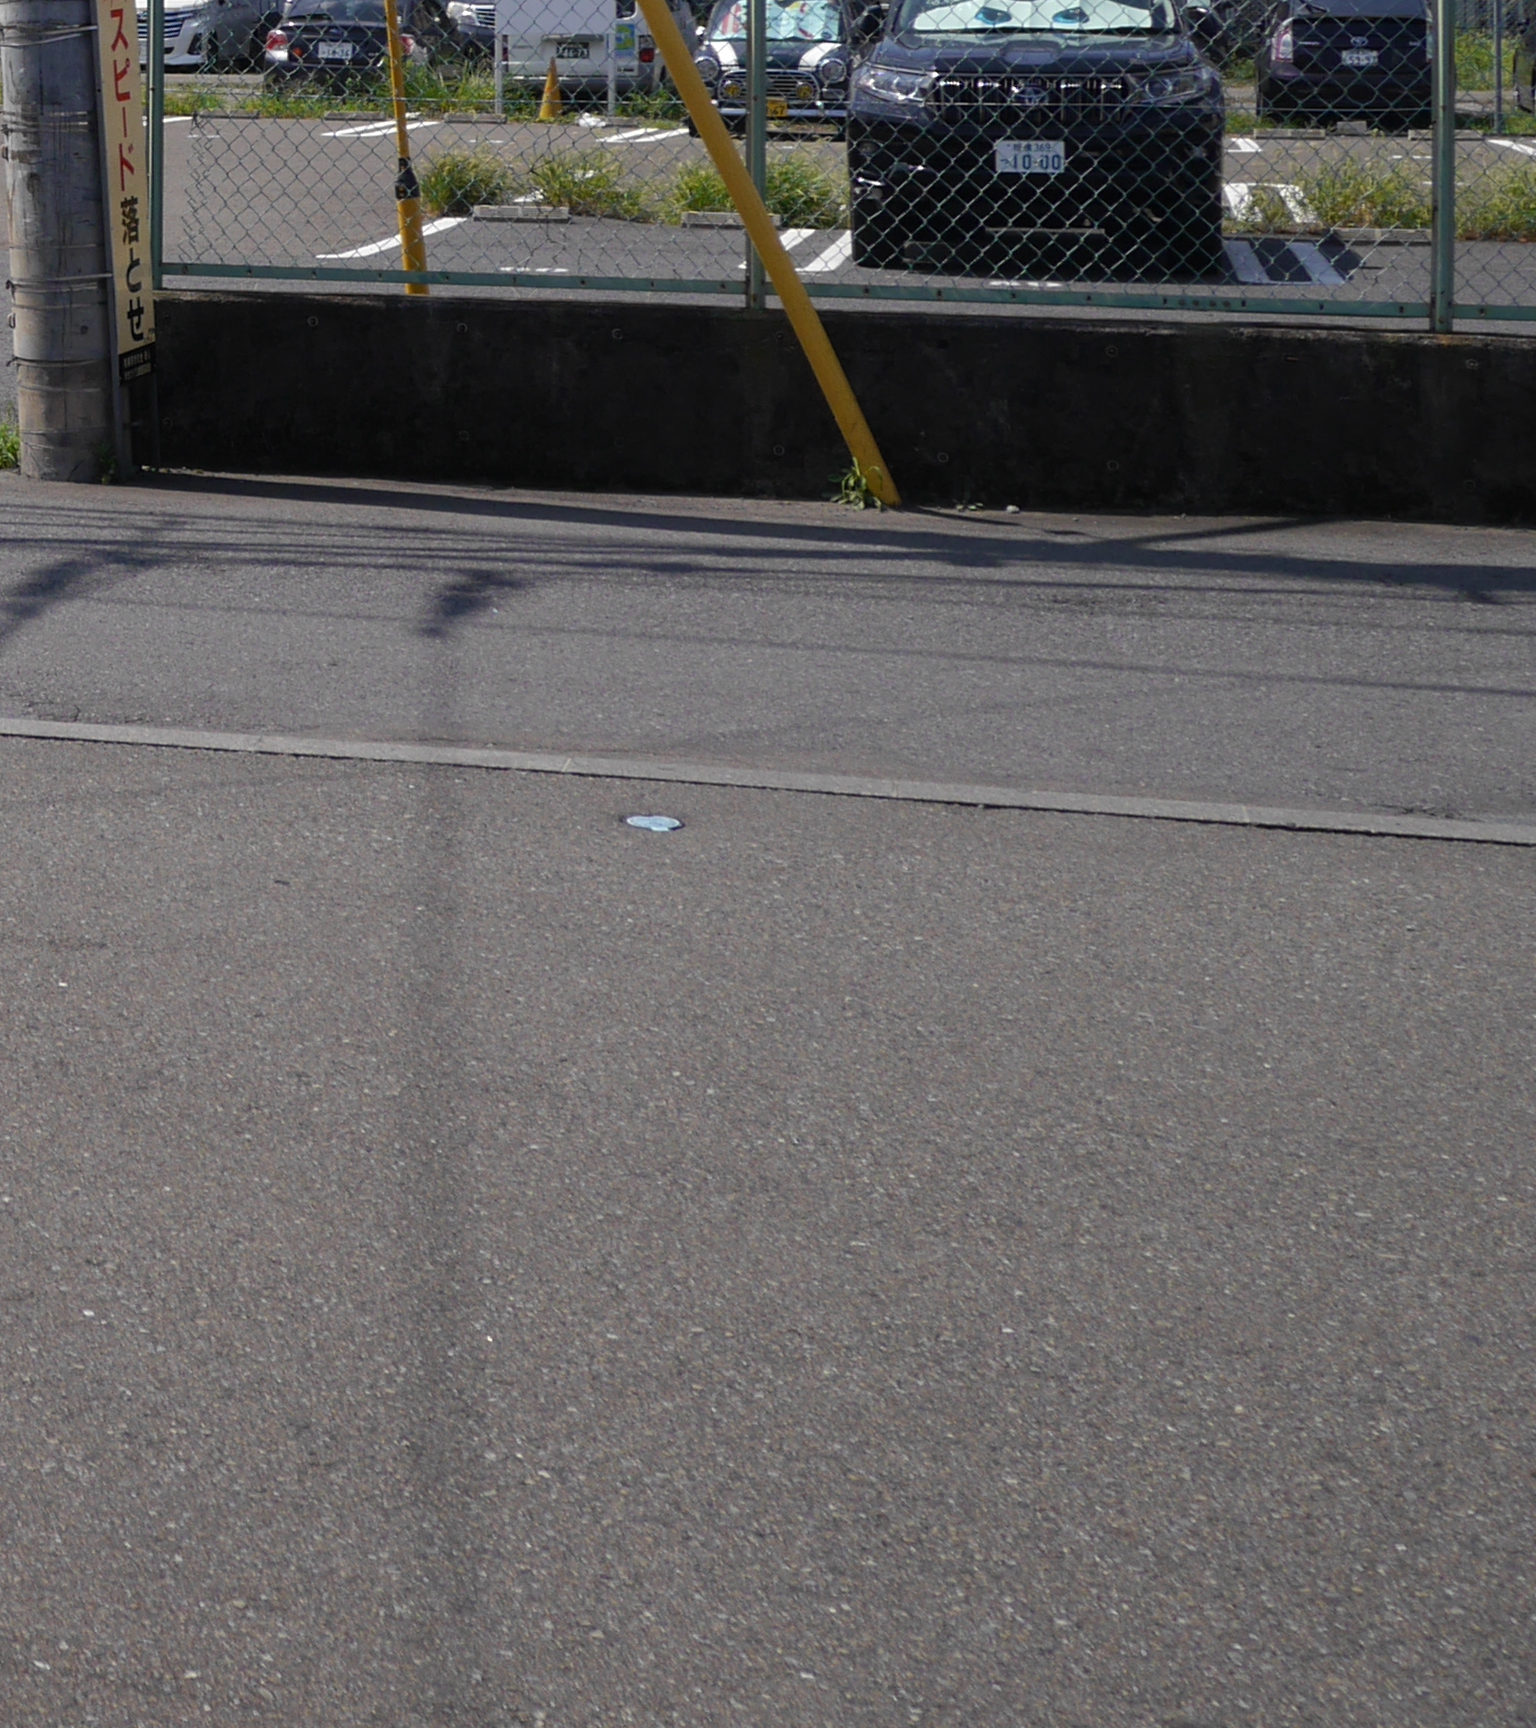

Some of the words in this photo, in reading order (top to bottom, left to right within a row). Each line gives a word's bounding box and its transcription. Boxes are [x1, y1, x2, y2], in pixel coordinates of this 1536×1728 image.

[110, 8, 145, 342] スピード落とせ
